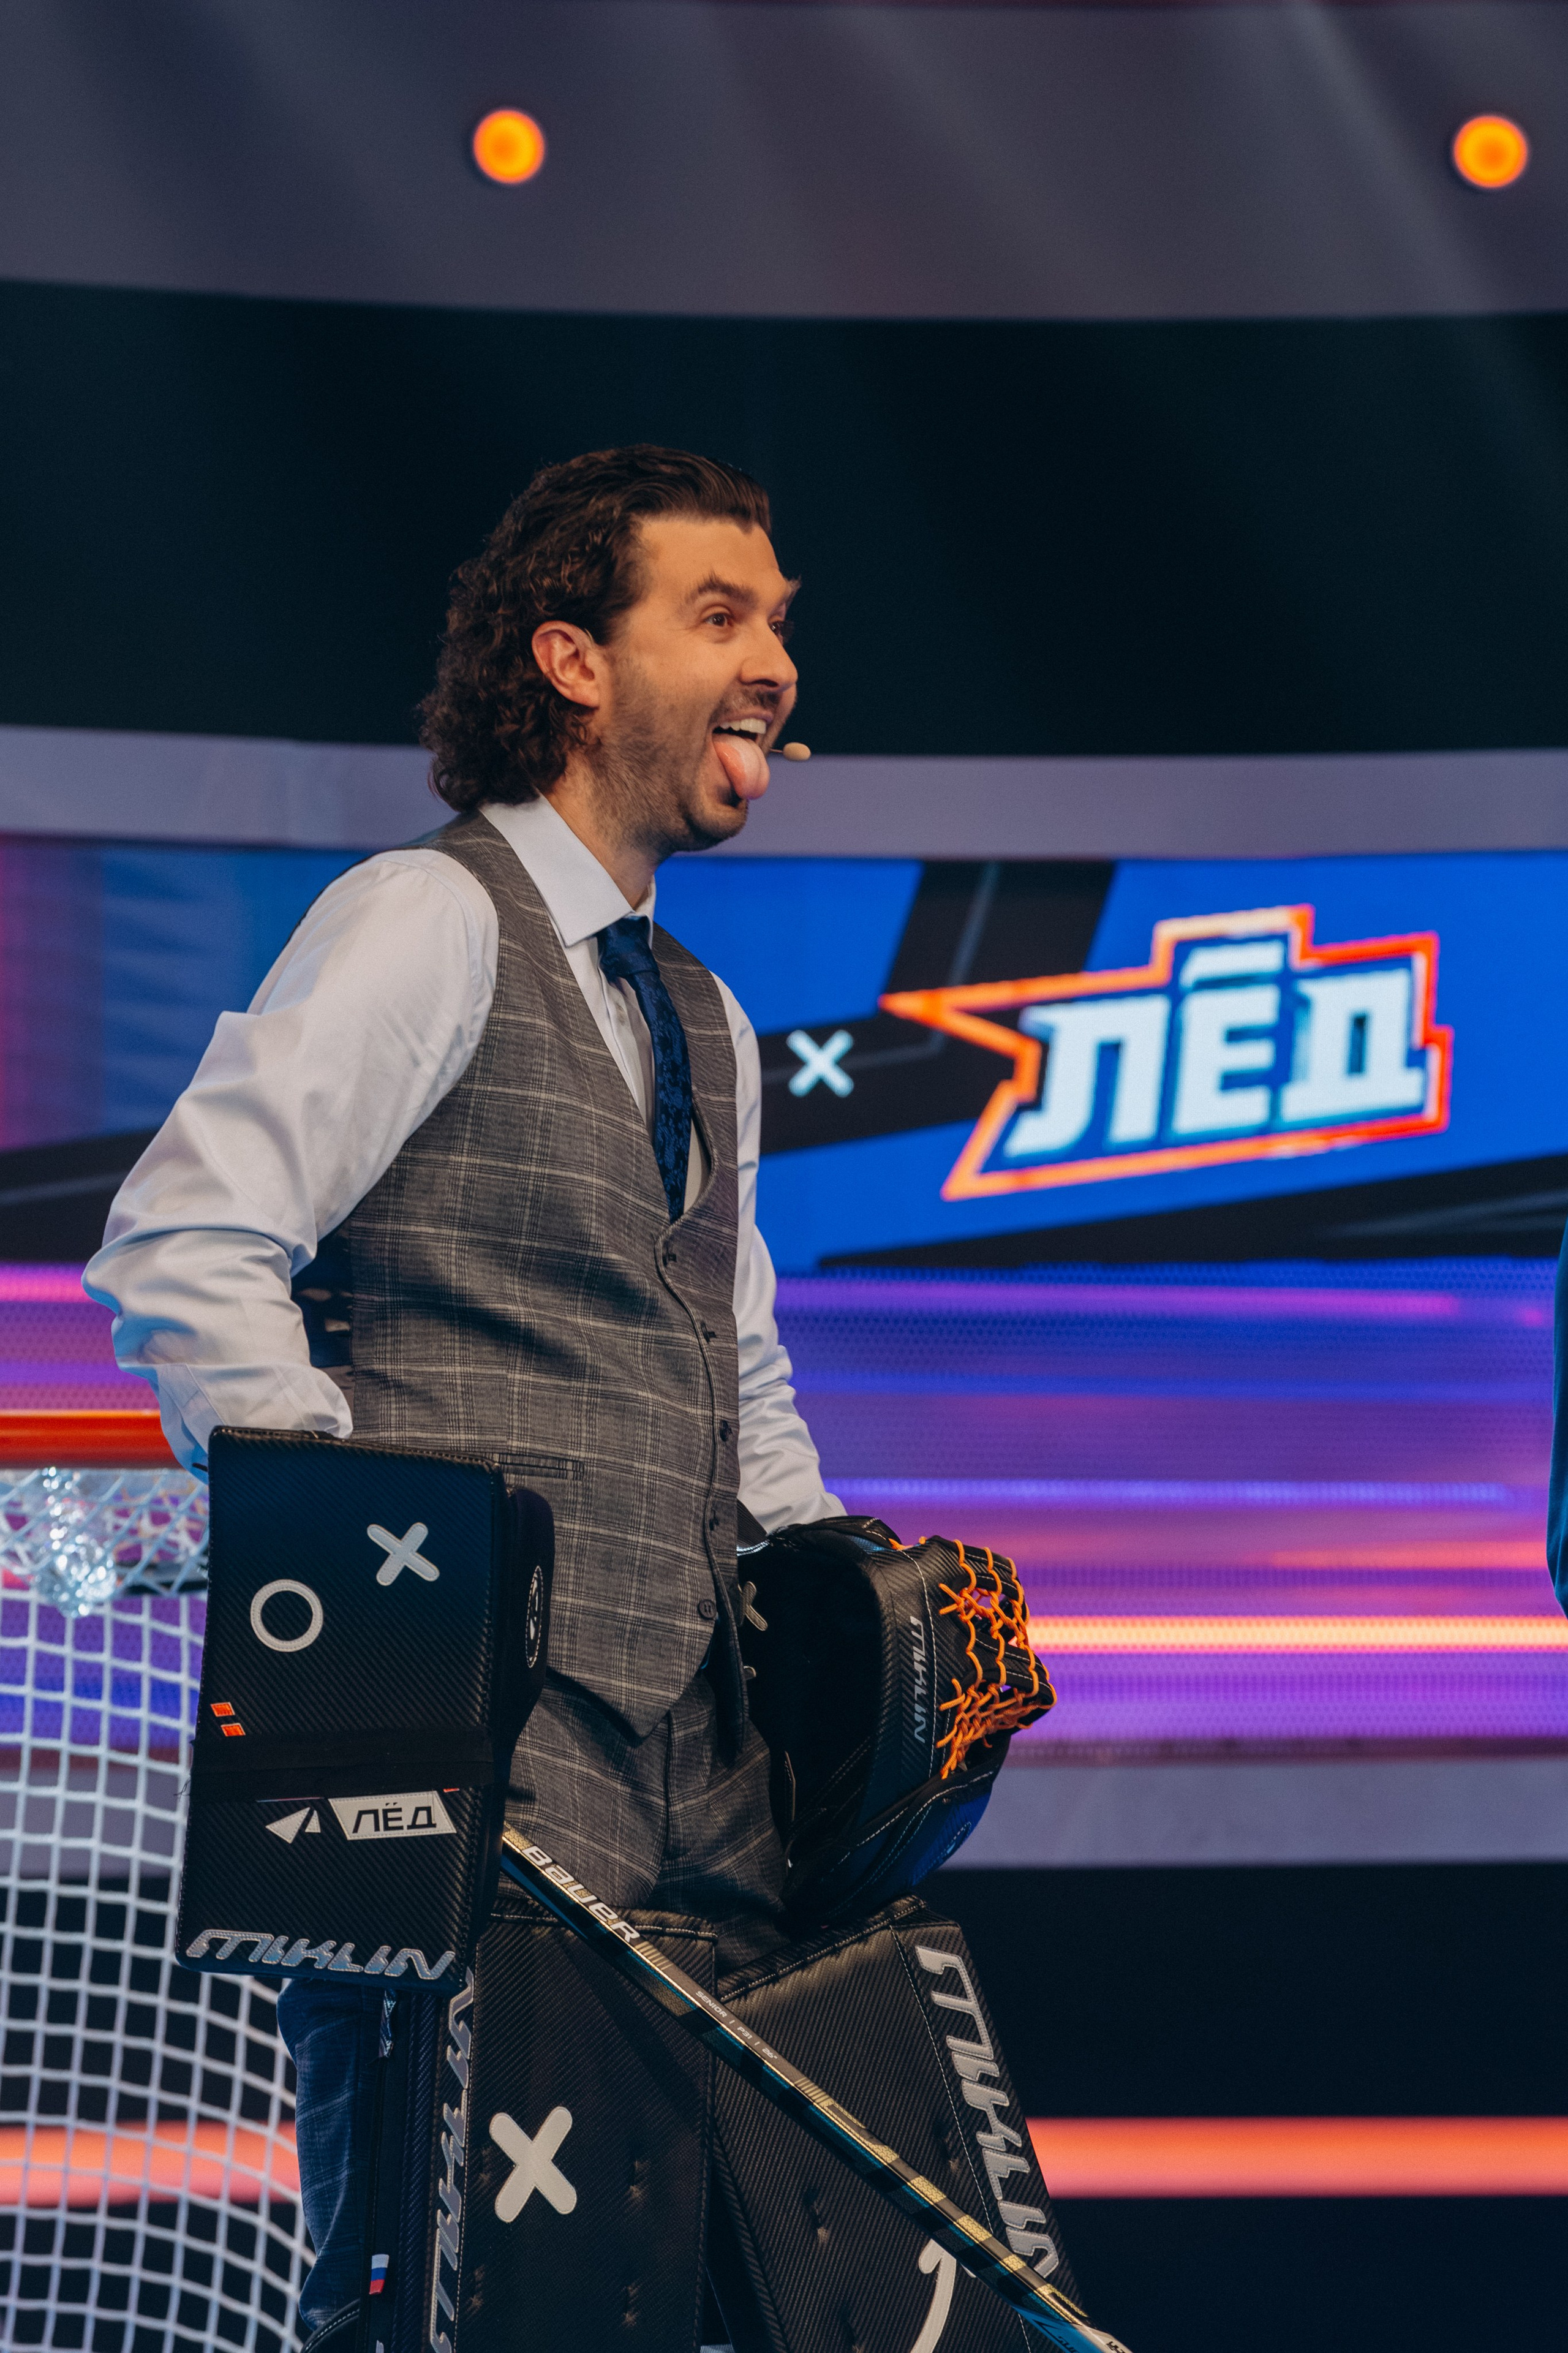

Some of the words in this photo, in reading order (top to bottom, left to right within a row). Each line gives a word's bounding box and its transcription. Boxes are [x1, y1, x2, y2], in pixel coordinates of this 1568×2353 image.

[1003, 939, 1425, 1157] ЛЁД
[352, 1802, 436, 1834] ЛЁД
[186, 1929, 455, 1979] MIKLIN
[695, 1991, 728, 2018] SENIOR
[737, 2026, 753, 2039] P31
